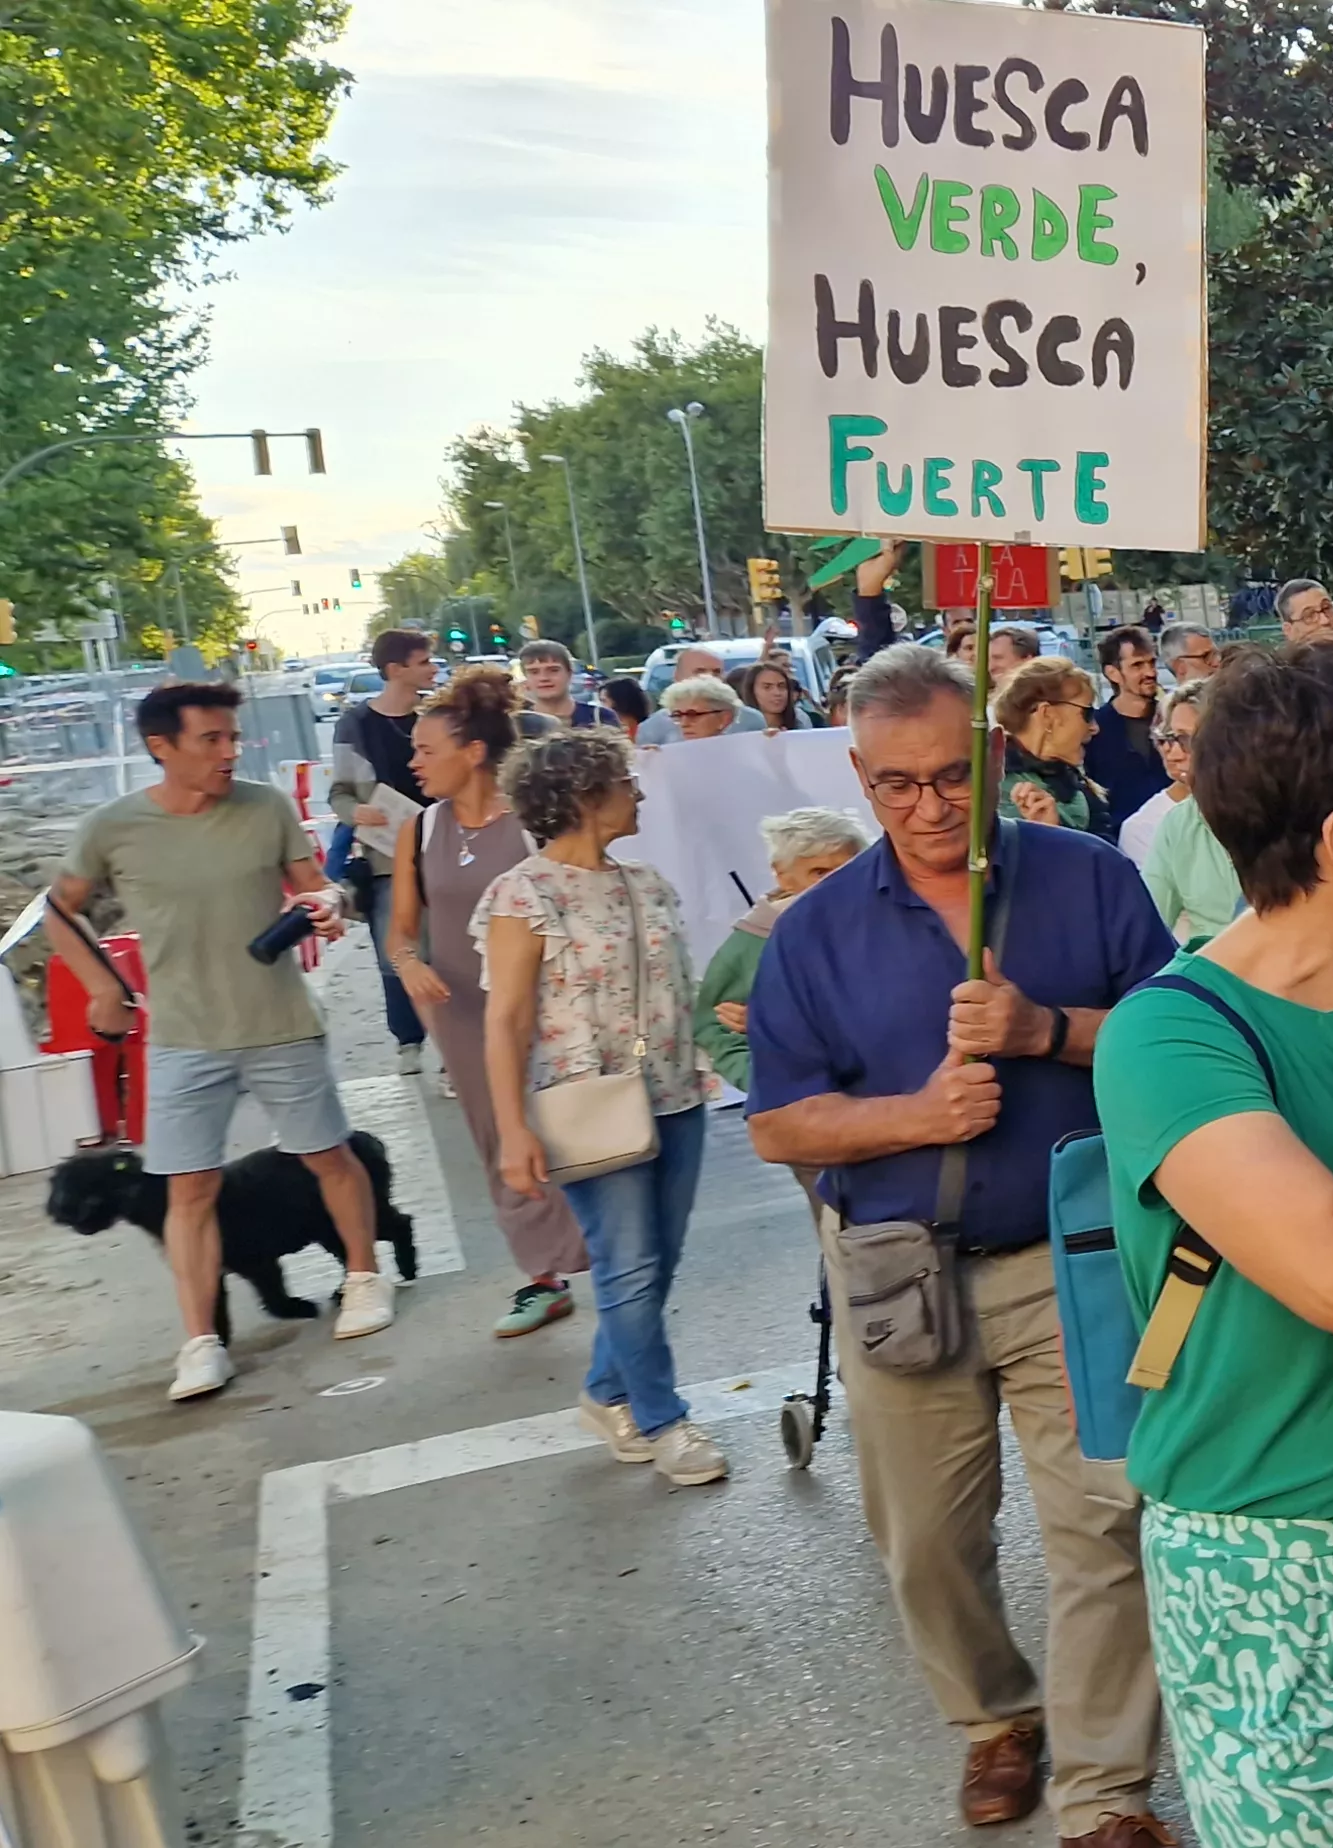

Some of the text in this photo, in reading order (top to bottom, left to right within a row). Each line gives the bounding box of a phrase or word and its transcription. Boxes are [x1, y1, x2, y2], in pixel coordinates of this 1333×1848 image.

[830, 16, 1149, 157] HUESCA
[874, 164, 1146, 285] VERDE,
[814, 273, 1135, 391] HUESCA
[828, 414, 1109, 525] FUERTE
